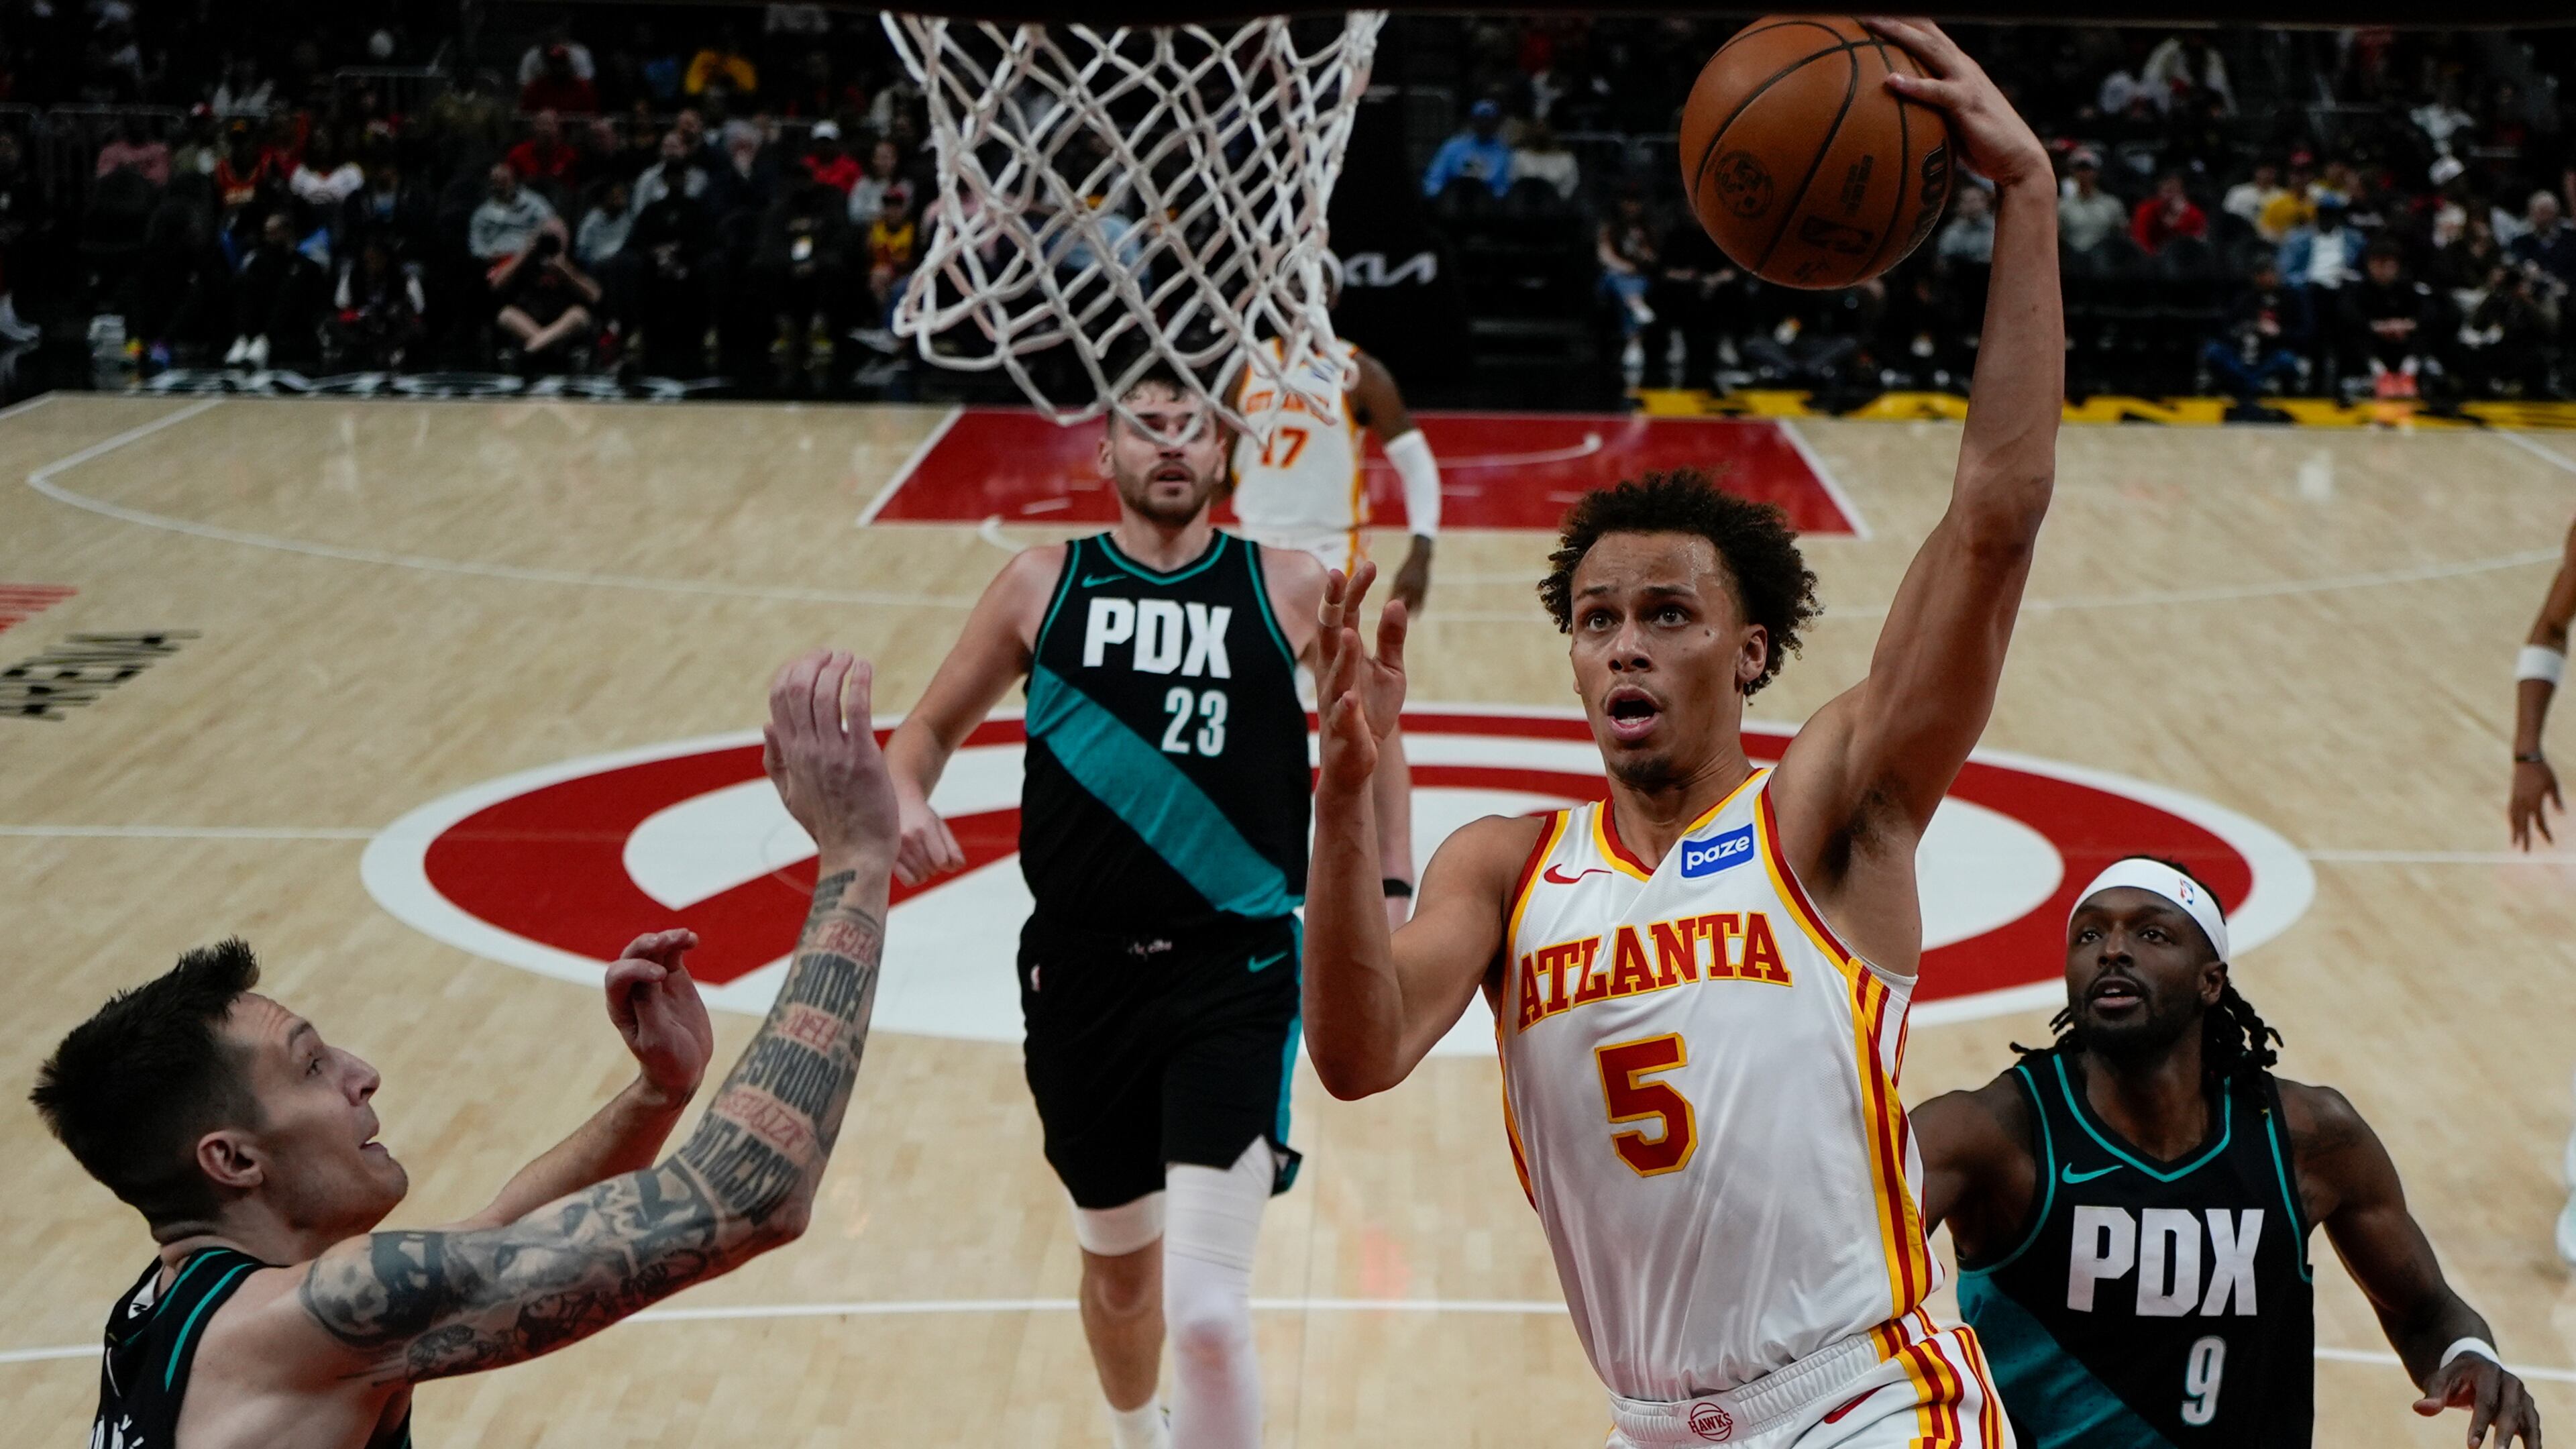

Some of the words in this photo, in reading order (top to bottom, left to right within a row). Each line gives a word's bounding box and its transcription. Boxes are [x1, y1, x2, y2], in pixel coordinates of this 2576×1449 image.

[1082, 597, 1232, 679] PDX
[1161, 686, 1228, 757] 23
[1686, 832, 1750, 870] paze
[1517, 912, 1792, 1034] ATLANTA
[1595, 1032, 1699, 1177] 5
[2067, 1205, 2265, 1317] PDX
[1688, 1412, 1733, 1435] HAWKS
[2181, 1335, 2226, 1427] 9
